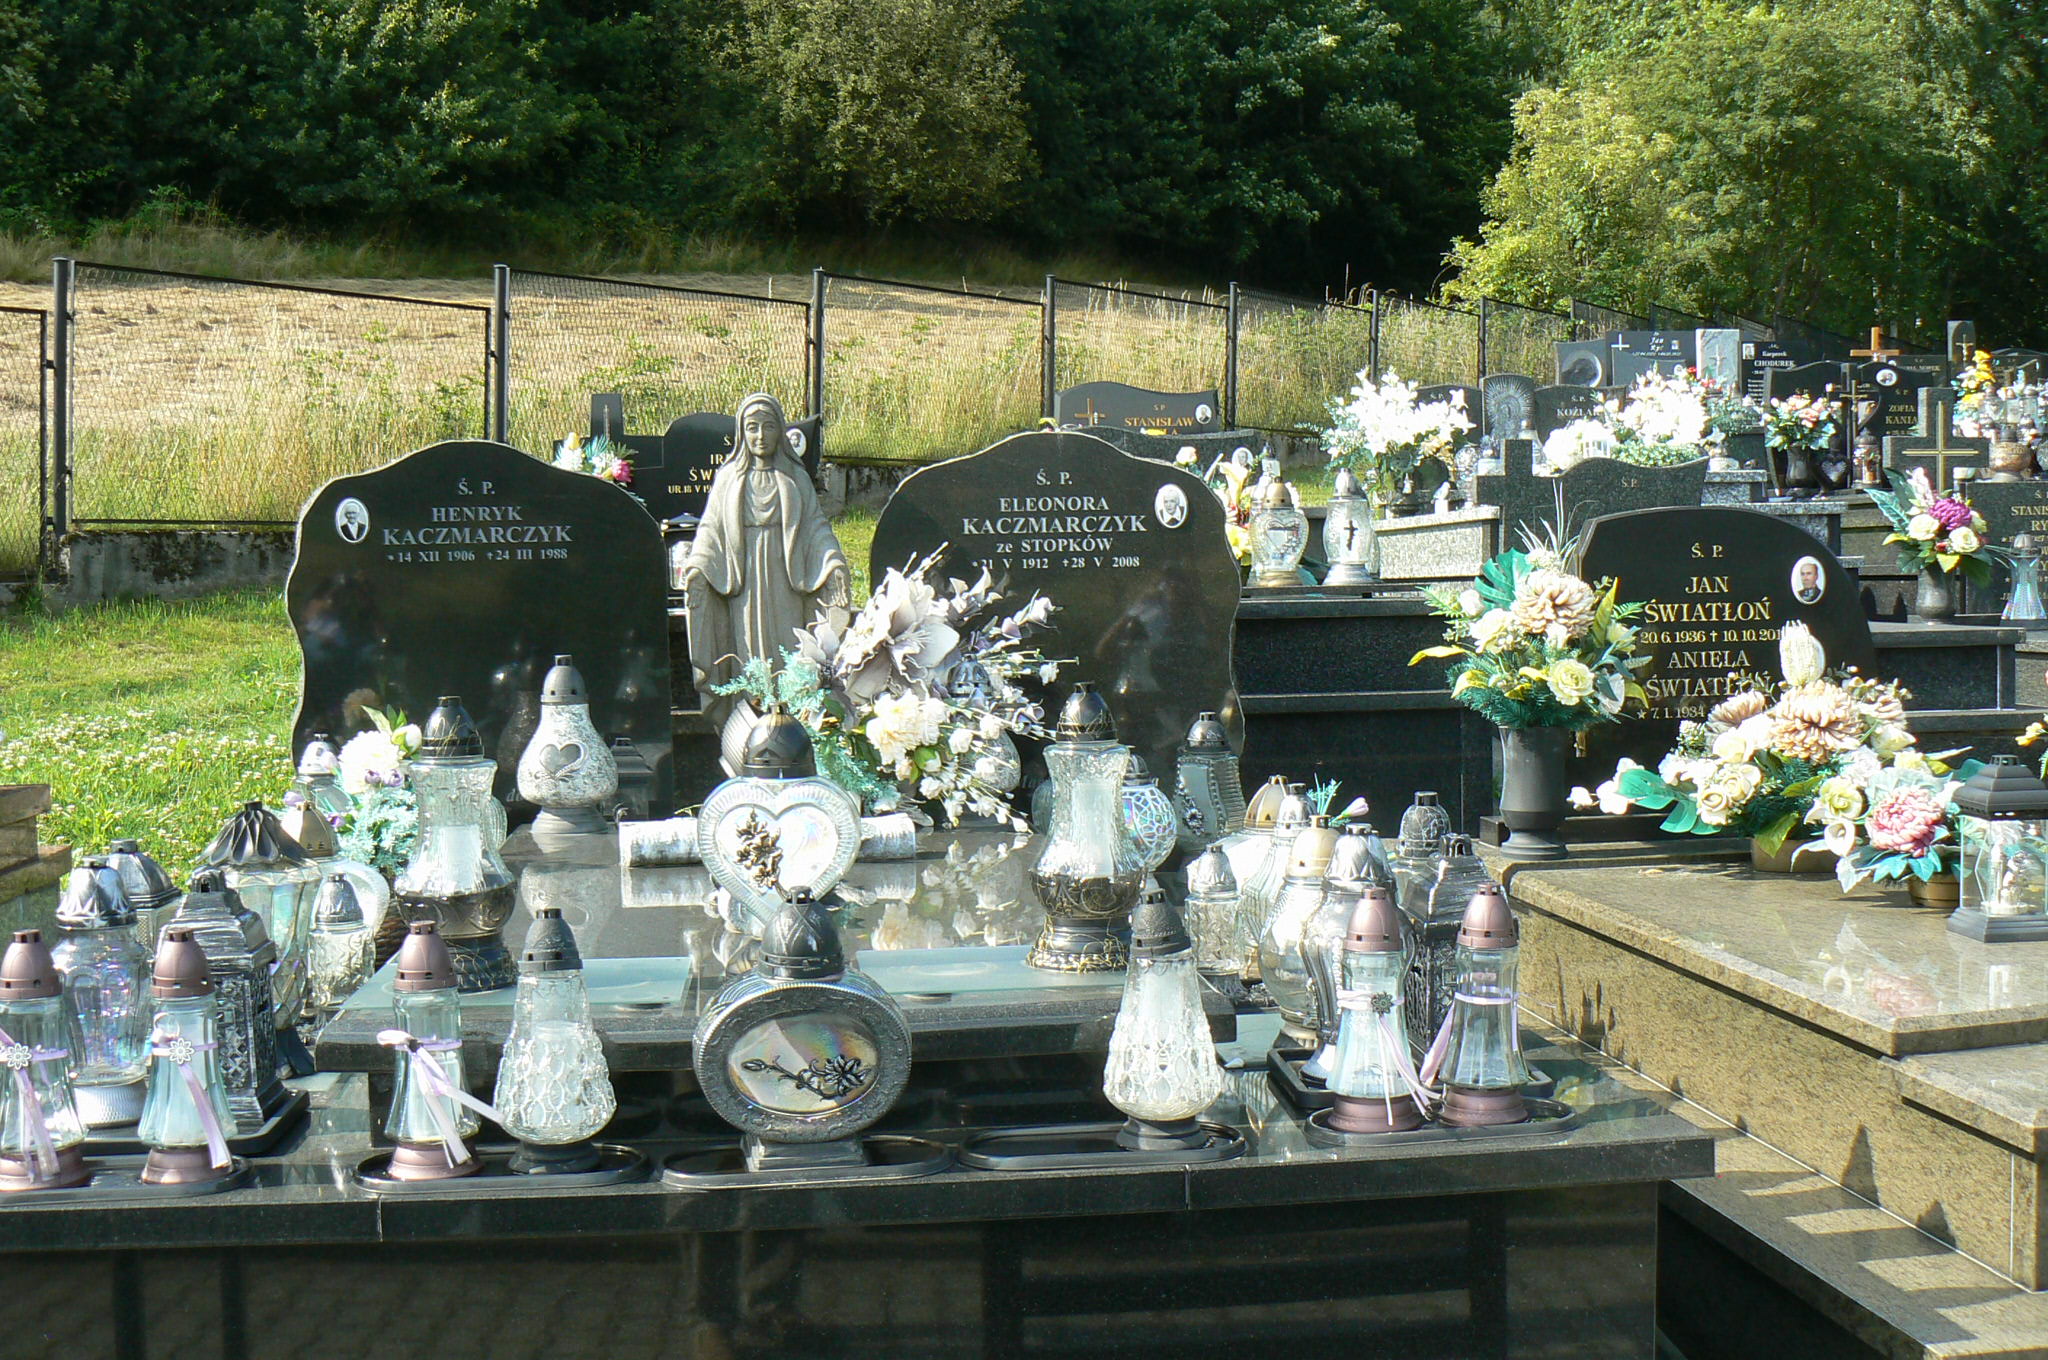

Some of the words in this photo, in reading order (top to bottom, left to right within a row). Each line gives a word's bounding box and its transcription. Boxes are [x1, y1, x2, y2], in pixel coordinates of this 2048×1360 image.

[1888, 404, 1915, 412] ZOFIA
[1036, 468, 1051, 486] Ś.
[1060, 471, 1073, 485] P.
[458, 477, 473, 495] Ś.
[481, 481, 496, 495] P.
[1000, 496, 1110, 512] ELEONORA
[431, 506, 523, 522] HENRYK
[962, 514, 1148, 535] KACZMARCZYK
[383, 525, 573, 546] KACZMARCZYK
[996, 543, 1013, 553] ze
[1021, 534, 1114, 553] STOPKÓW
[418, 551, 441, 562] XII
[447, 550, 475, 562] 1906
[516, 548, 533, 560] III
[540, 548, 568, 560] 1988
[1691, 542, 1705, 558] Ś.
[1712, 544, 1724, 558] P.
[1002, 558, 1013, 568] V
[1022, 557, 1049, 569] 1912
[1093, 556, 1104, 567] V
[1112, 556, 1140, 568] 2008
[1685, 576, 1729, 593] JAN
[1644, 596, 1771, 624] ŚWIATŁOŃ
[1758, 628, 1782, 641] 201
[1667, 650, 1751, 669] ANIELA
